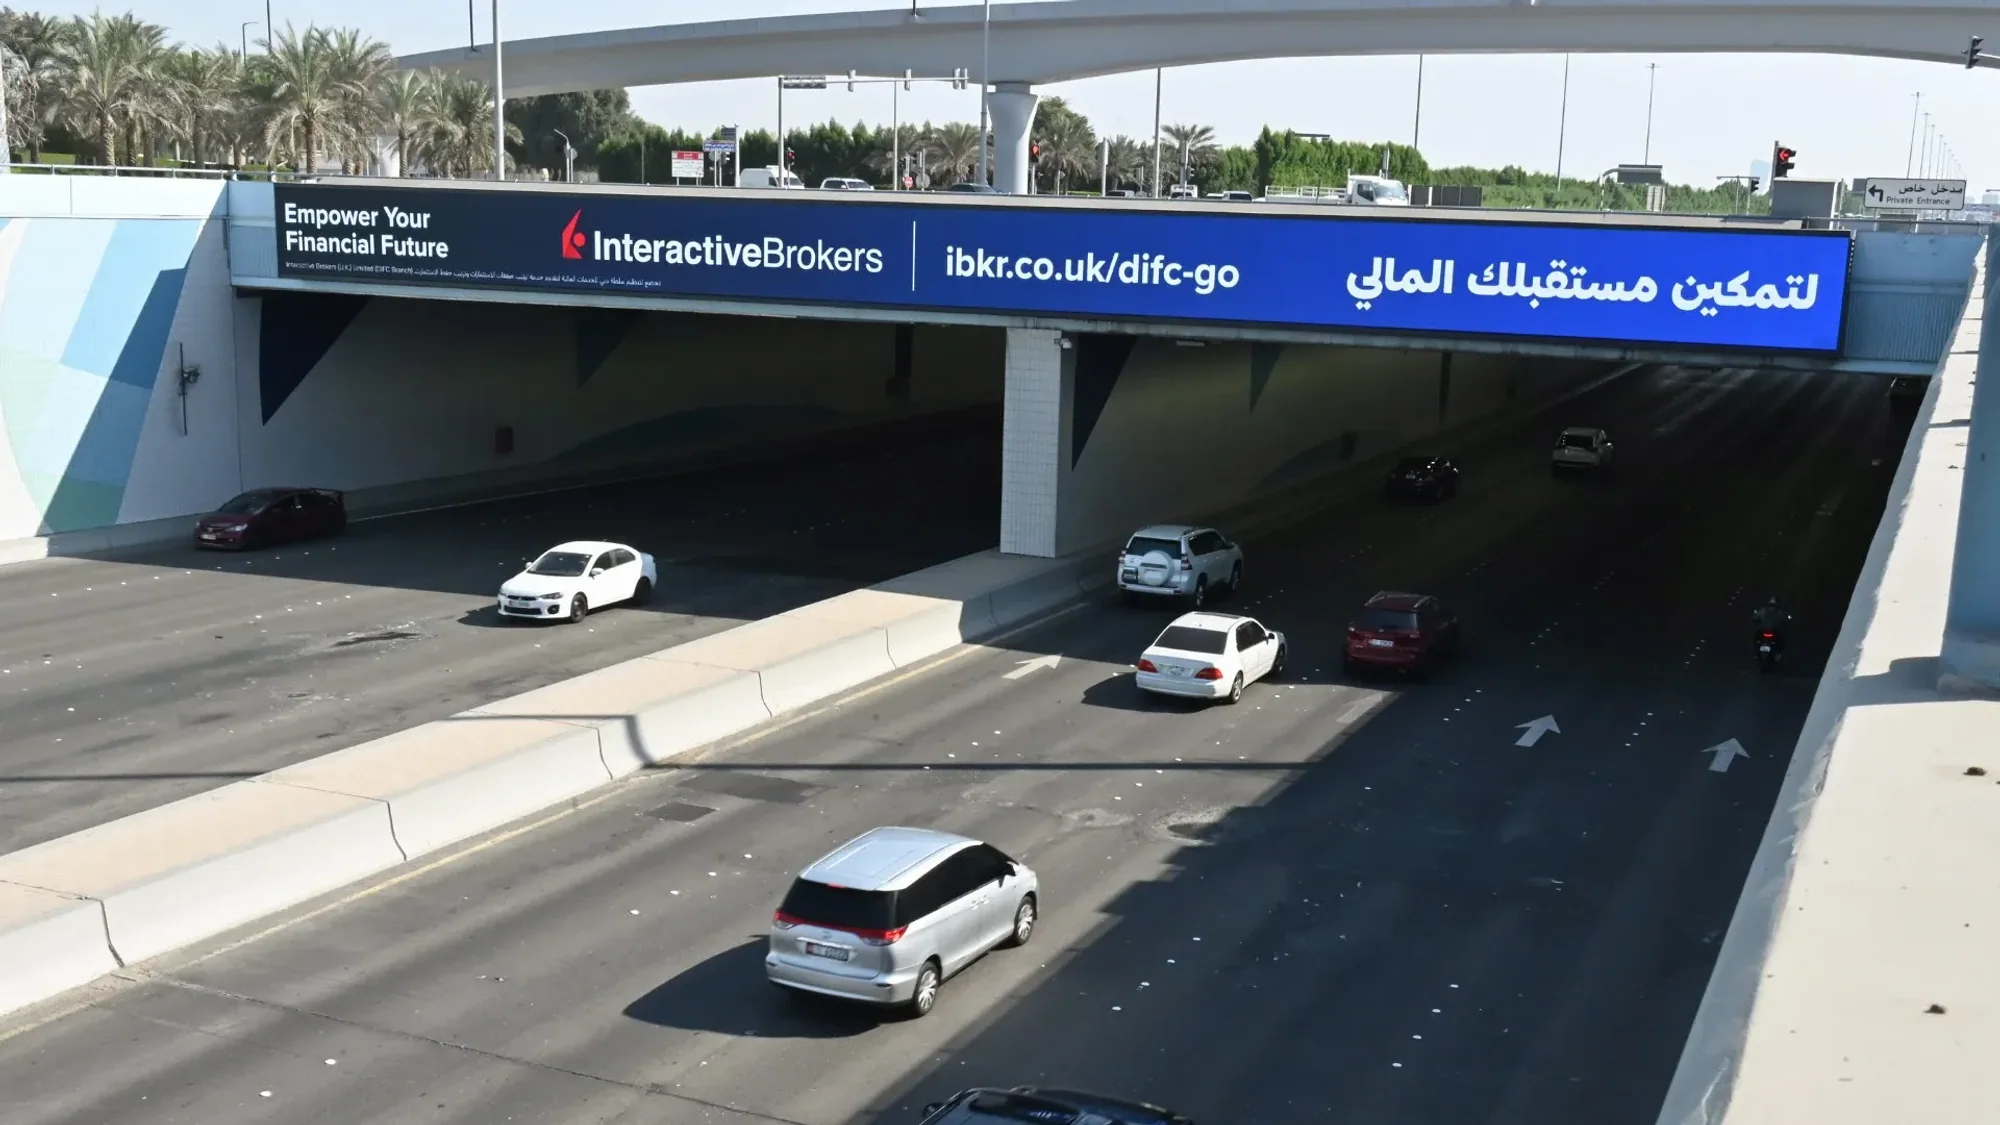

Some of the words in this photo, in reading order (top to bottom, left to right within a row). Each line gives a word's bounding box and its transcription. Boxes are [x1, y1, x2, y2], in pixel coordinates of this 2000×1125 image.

[1886, 195, 1914, 205] Private
[1916, 196, 1951, 206] Entrance
[1898, 183, 1926, 195] خاص
[1931, 183, 1963, 195] مدخل
[284, 202, 379, 230] Empower
[383, 206, 431, 229] Your
[285, 230, 376, 255] Financial
[381, 234, 450, 259] Future
[594, 230, 883, 273] InteractiveBrokers
[946, 245, 1240, 295] ibkr.co.uk/difc-go
[1346, 256, 1455, 311] المالي
[1467, 259, 1658, 309] مستقبلك
[1671, 270, 1819, 317] لتمكين
